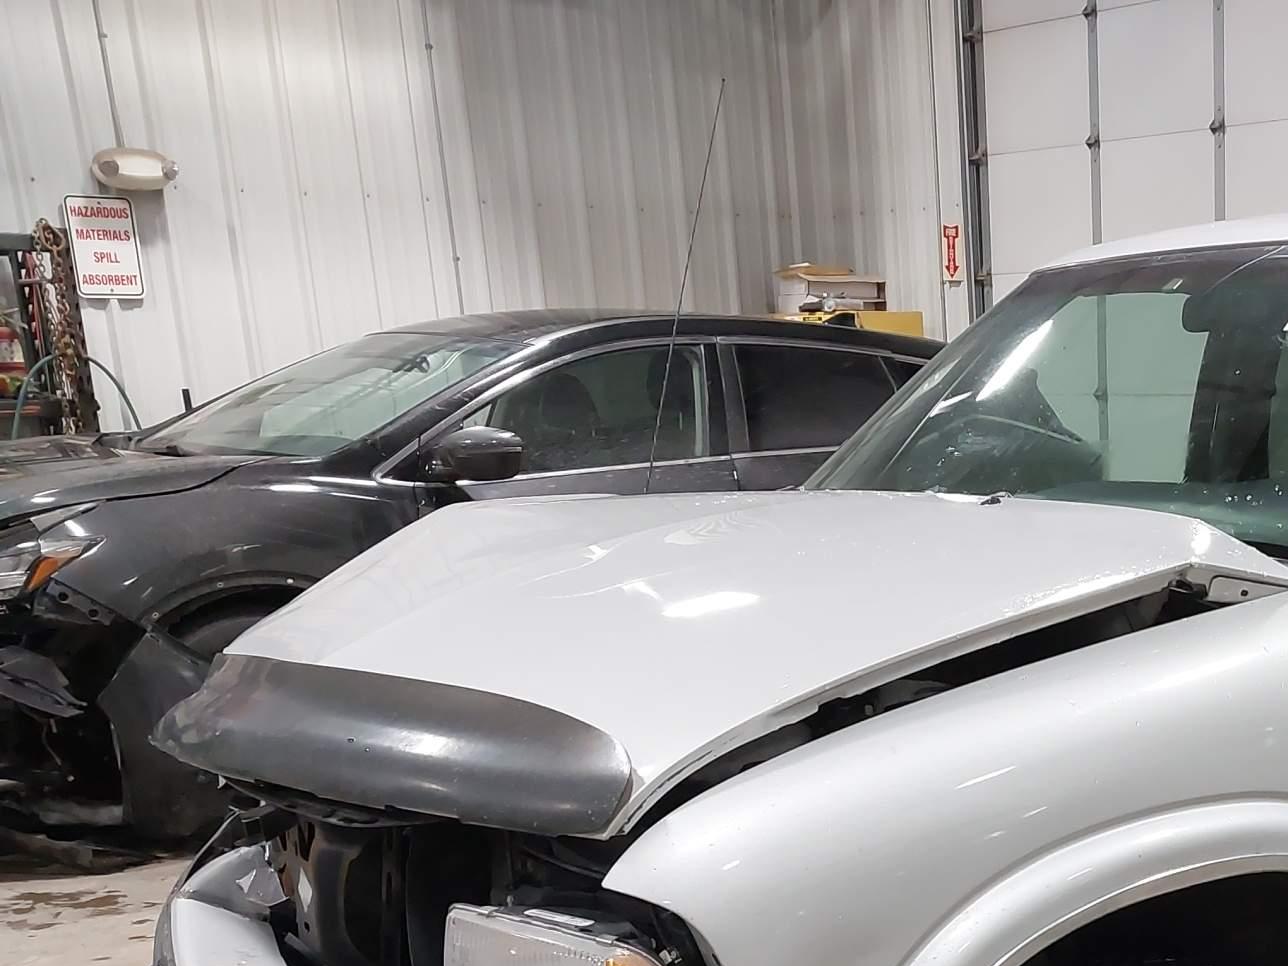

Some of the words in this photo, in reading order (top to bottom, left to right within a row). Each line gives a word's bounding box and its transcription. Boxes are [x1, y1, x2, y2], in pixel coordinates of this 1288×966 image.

[69, 205, 129, 219] HAZARDOUS
[75, 228, 131, 242] MATERIALS
[93, 251, 121, 264] SPILL
[82, 273, 138, 286] ABSORBENT
